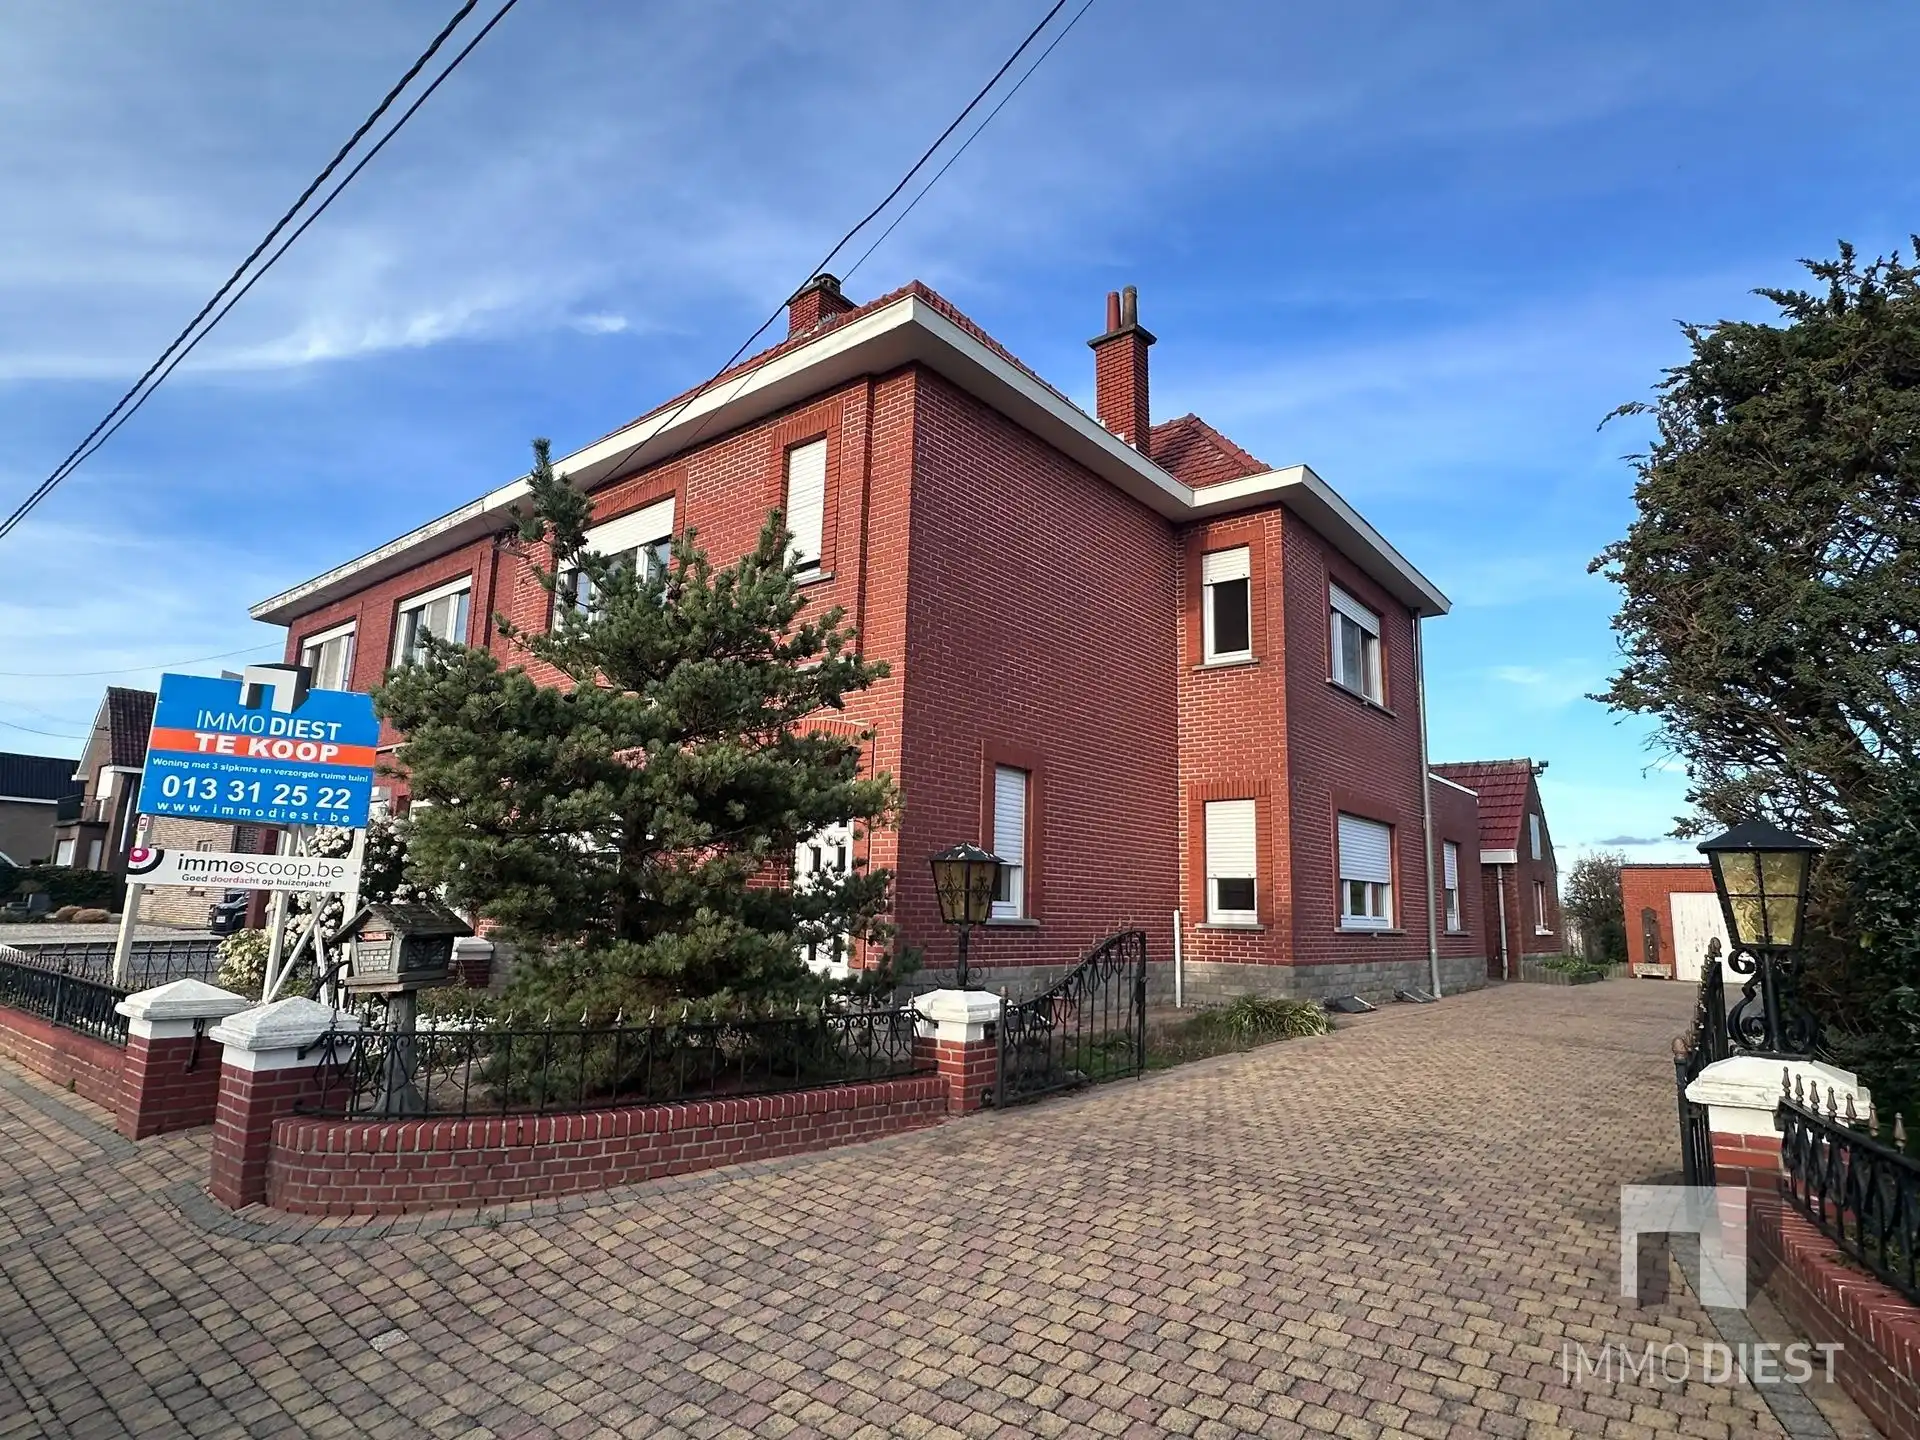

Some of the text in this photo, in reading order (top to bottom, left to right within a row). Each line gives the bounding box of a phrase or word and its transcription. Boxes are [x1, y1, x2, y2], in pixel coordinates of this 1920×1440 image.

[196, 709, 342, 742] IMMO DIEST
[194, 732, 339, 763] TE KOOP
[152, 757, 189, 769] Woning
[211, 762, 218, 770] 3
[220, 763, 258, 773] slpkmrs
[274, 768, 319, 779] verzorgde
[320, 772, 347, 781] ruime
[348, 774, 368, 783] tuin!
[162, 774, 351, 810] 013 31 25 22
[157, 801, 350, 823] www.immodiest.be
[177, 853, 344, 880] immoscoop.be
[181, 873, 332, 888] Goed doordacht op huizenjacht!
